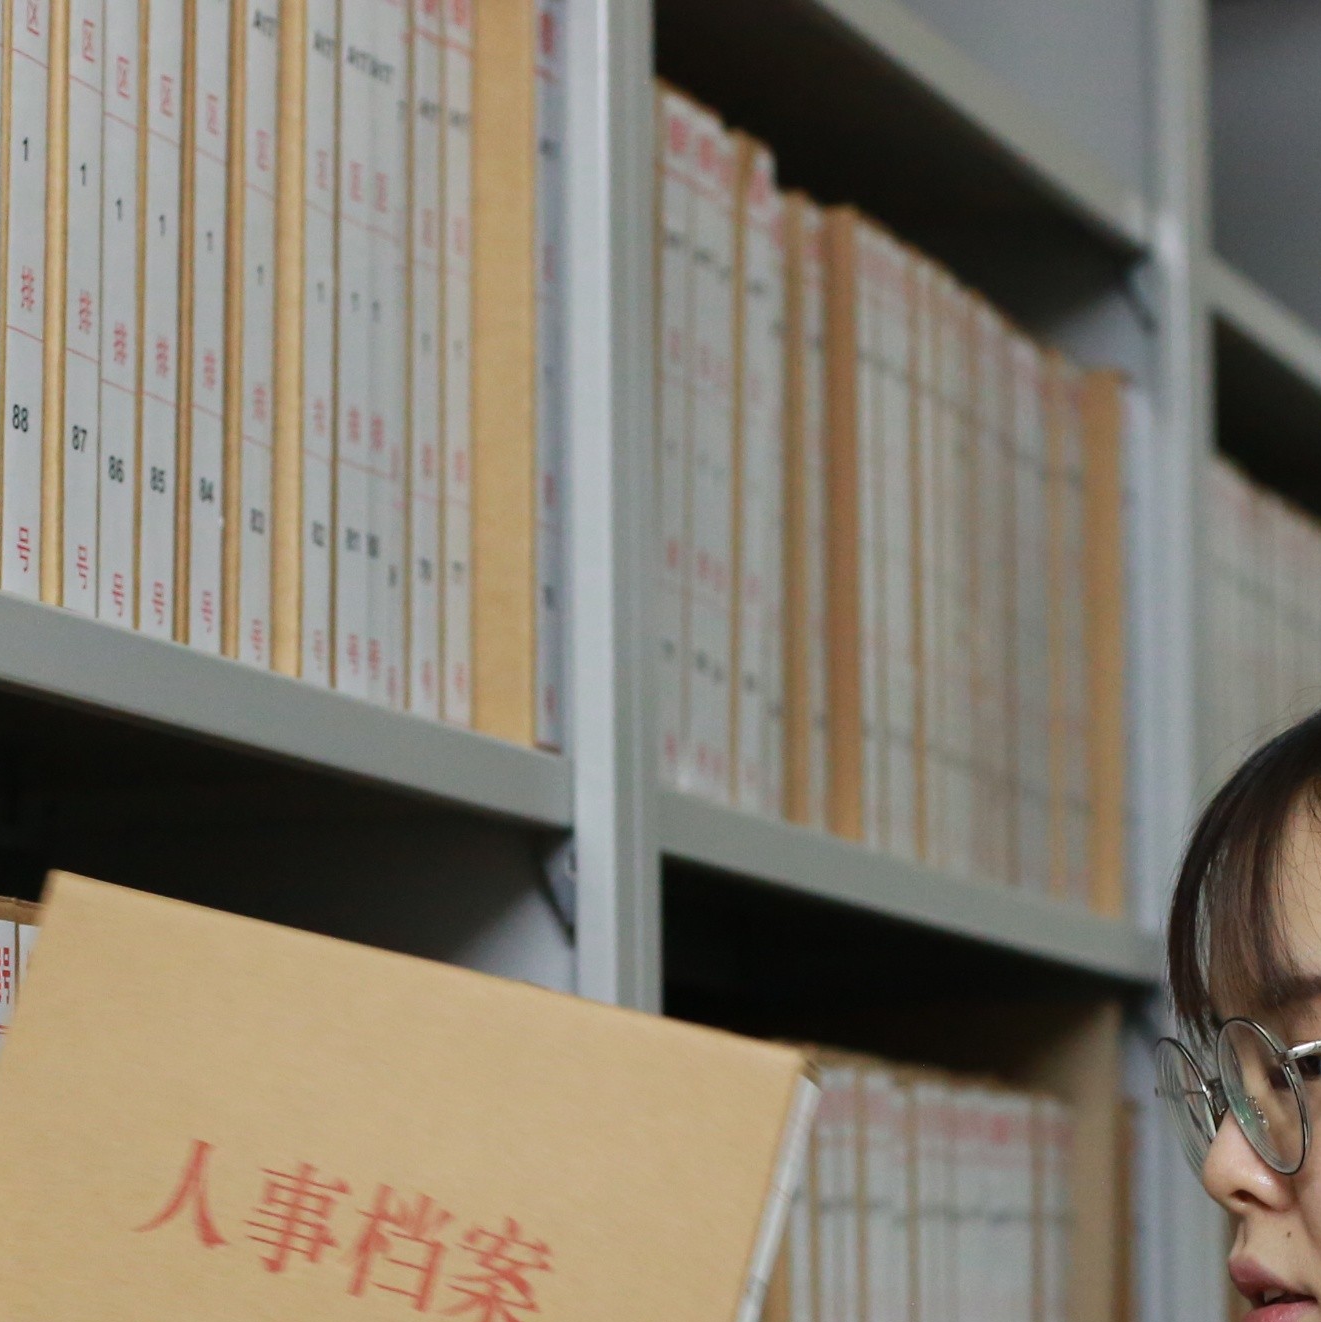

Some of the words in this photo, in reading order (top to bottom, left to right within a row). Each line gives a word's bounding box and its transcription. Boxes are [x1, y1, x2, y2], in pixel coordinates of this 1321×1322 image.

[22, 137, 29, 161] 1
[80, 163, 87, 186] 1
[12, 404, 28, 433] 88
[72, 425, 87, 451] 87
[108, 455, 124, 483] 86
[17, 527, 30, 572] 号
[77, 545, 89, 590] 号
